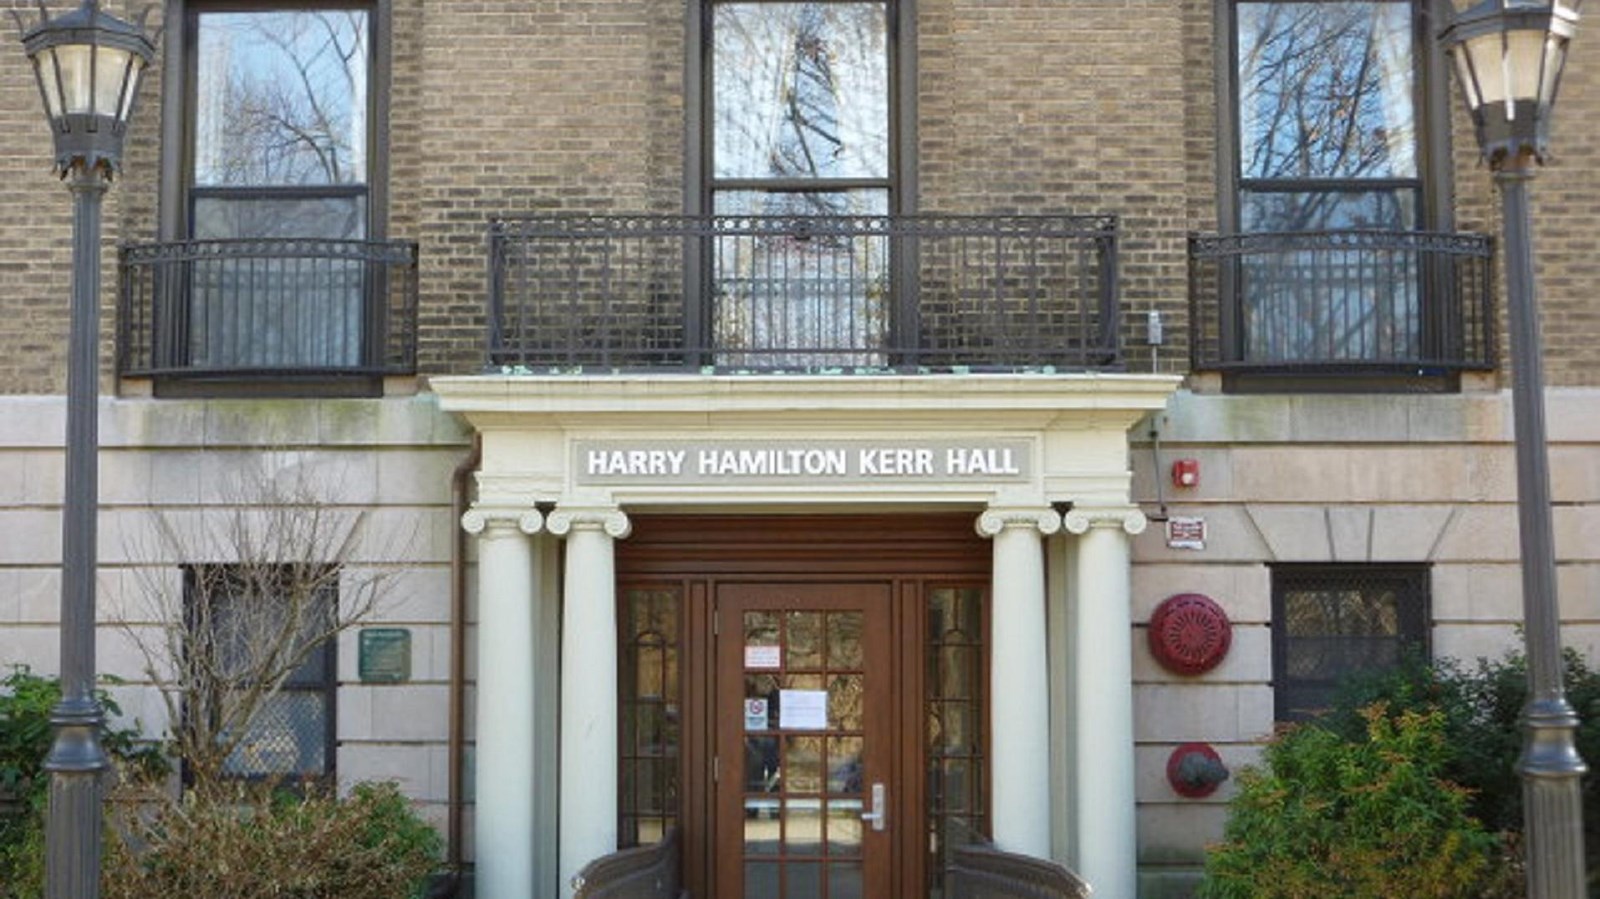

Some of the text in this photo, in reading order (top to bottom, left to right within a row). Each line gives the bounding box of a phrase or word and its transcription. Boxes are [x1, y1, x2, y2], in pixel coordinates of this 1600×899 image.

[588, 449, 1019, 474] HARRY HAMILTON KERR HALL
